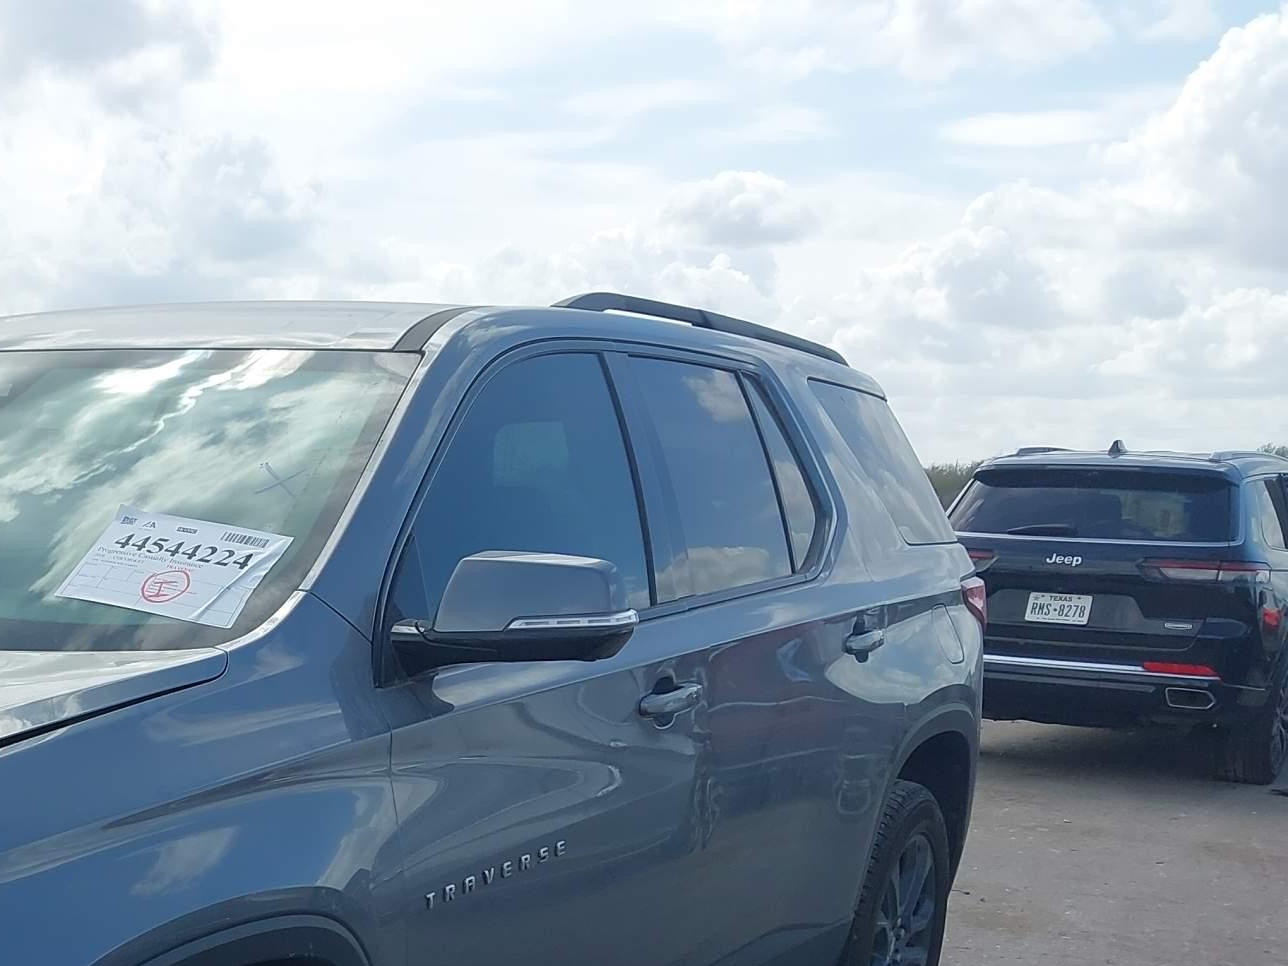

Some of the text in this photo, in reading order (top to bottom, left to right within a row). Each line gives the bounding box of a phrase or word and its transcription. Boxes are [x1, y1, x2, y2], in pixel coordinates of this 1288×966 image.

[115, 533, 253, 570] 44544224
[1046, 553, 1082, 567] Jeep
[425, 840, 567, 910] TRAVERSE
